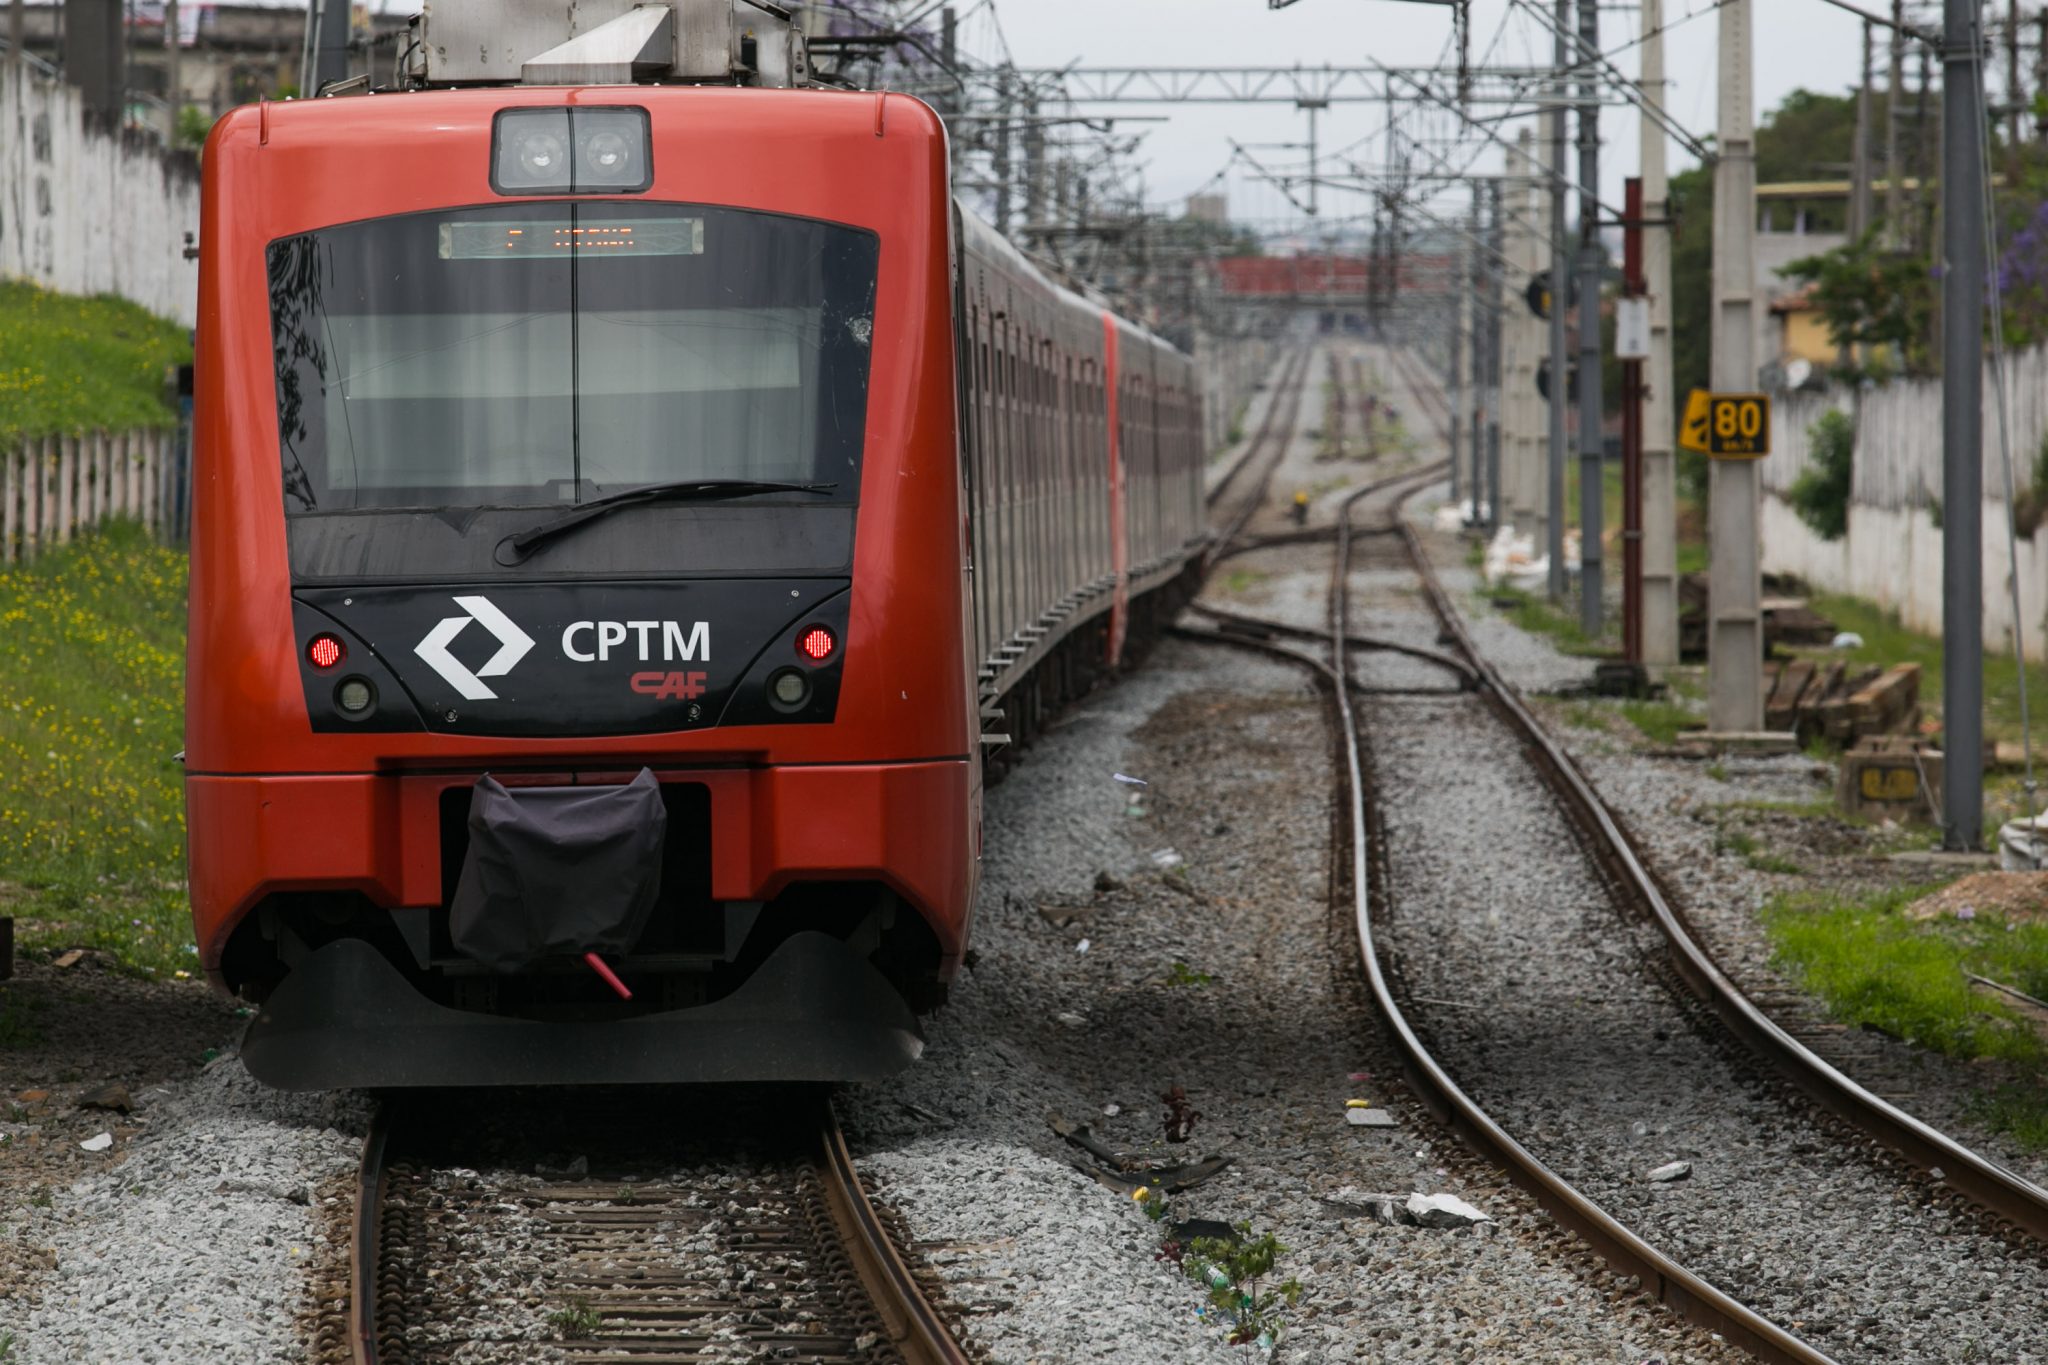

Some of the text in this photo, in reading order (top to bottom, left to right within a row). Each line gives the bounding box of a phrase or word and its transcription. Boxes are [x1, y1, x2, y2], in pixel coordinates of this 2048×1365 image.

[1715, 401, 1761, 439] 80
[561, 620, 711, 662] CPTM
[630, 671, 708, 700] CAF
